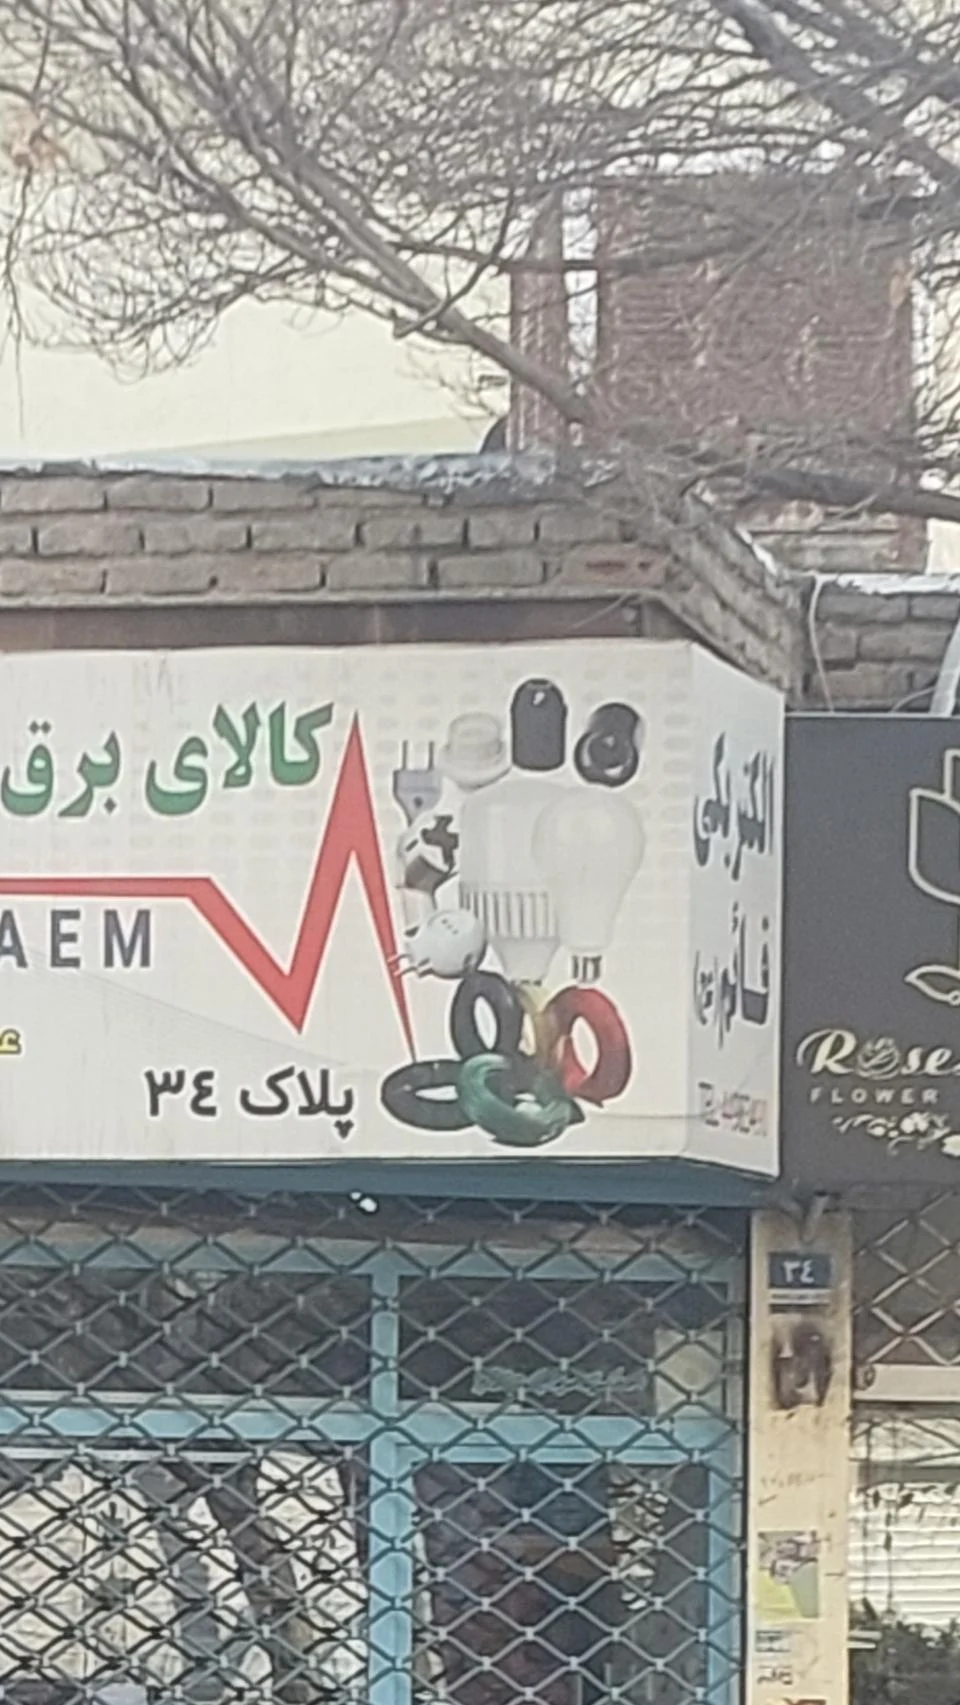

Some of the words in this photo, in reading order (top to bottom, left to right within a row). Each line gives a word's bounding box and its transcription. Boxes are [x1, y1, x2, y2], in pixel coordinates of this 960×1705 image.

[1, 720, 121, 818] برق
[146, 701, 335, 816] کالای
[239, 1066, 355, 1140] پلاک
[809, 1088, 939, 1105] FLOWER
